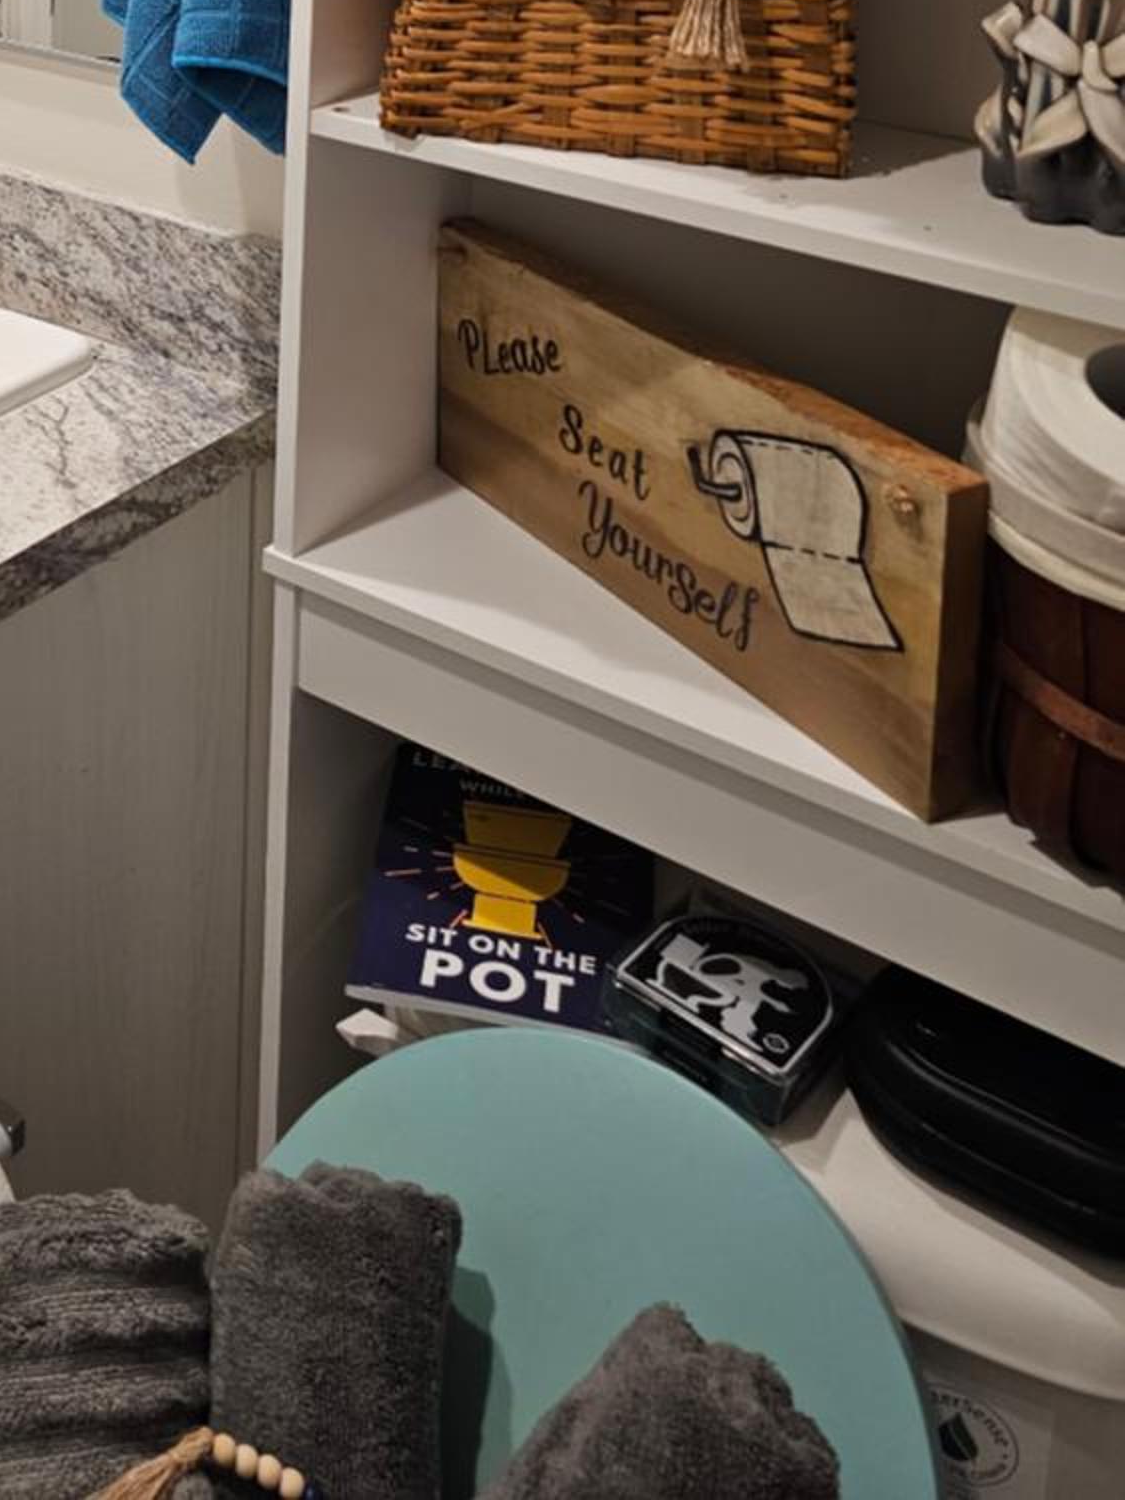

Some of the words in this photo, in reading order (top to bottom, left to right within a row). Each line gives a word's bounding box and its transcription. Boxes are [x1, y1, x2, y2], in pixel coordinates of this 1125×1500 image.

[558, 403, 651, 501] Seat
[405, 922, 458, 947] SIT
[468, 935, 522, 960] ON
[533, 945, 598, 975] THE
[419, 949, 575, 1013] POT
